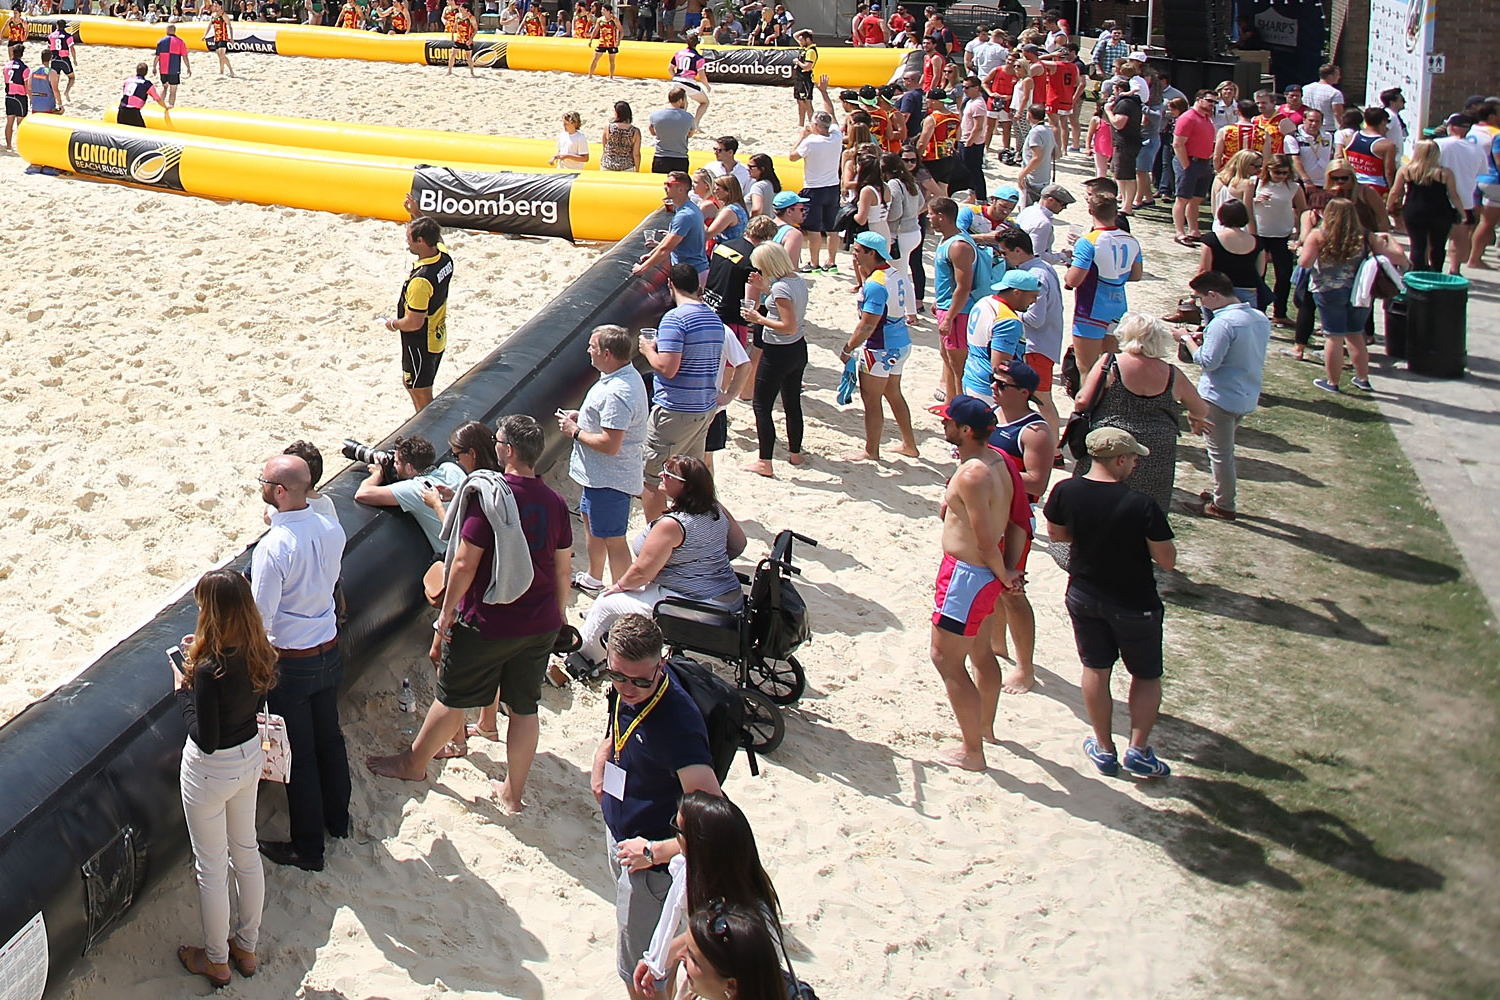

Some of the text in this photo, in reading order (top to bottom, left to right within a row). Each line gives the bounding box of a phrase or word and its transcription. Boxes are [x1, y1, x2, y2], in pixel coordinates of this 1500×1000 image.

[28, 22, 53, 33] ONDON
[7, 69, 15, 84] 2
[706, 60, 793, 79] Bloomberg
[1063, 72, 1072, 86] 6
[74, 141, 128, 168] LONDON
[75, 160, 128, 176] BEACH RUGBY
[419, 188, 558, 224] Bloomberg
[1112, 243, 1129, 271] 11
